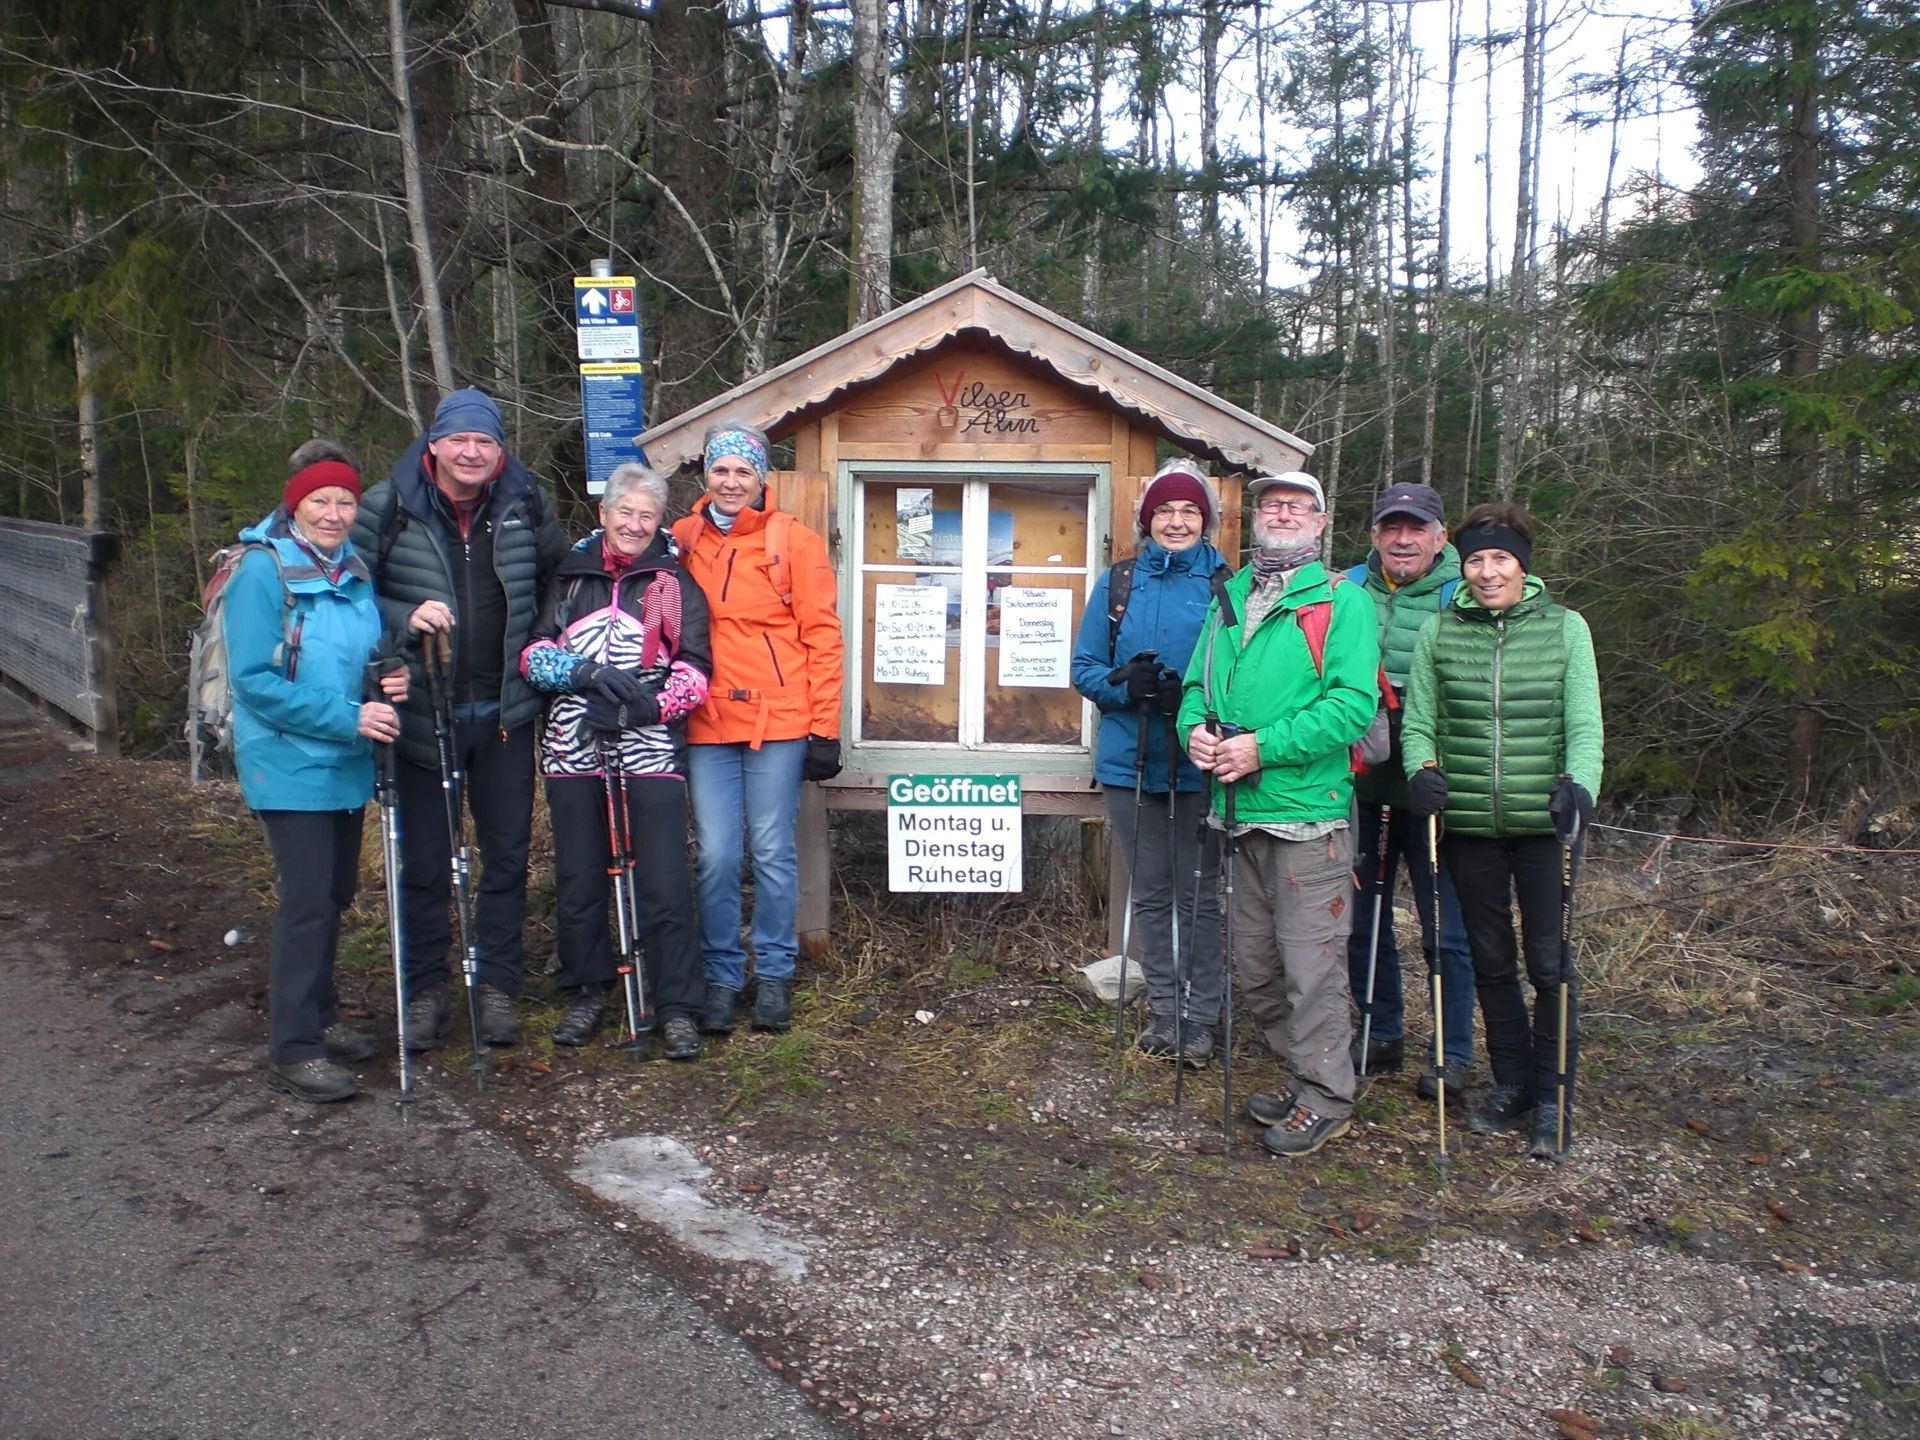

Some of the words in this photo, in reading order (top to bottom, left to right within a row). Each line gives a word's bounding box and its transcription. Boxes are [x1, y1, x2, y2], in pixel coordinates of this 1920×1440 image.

[933, 370, 1030, 408] Vilser
[960, 409, 1039, 434] Alm
[1018, 617, 1055, 630] Donnerstag
[890, 778, 1018, 803] Geöffnet
[898, 813, 982, 835] Montag
[991, 817, 1011, 831] u.
[905, 839, 1004, 861] Dienstag
[908, 865, 1002, 887] Ruhetag
